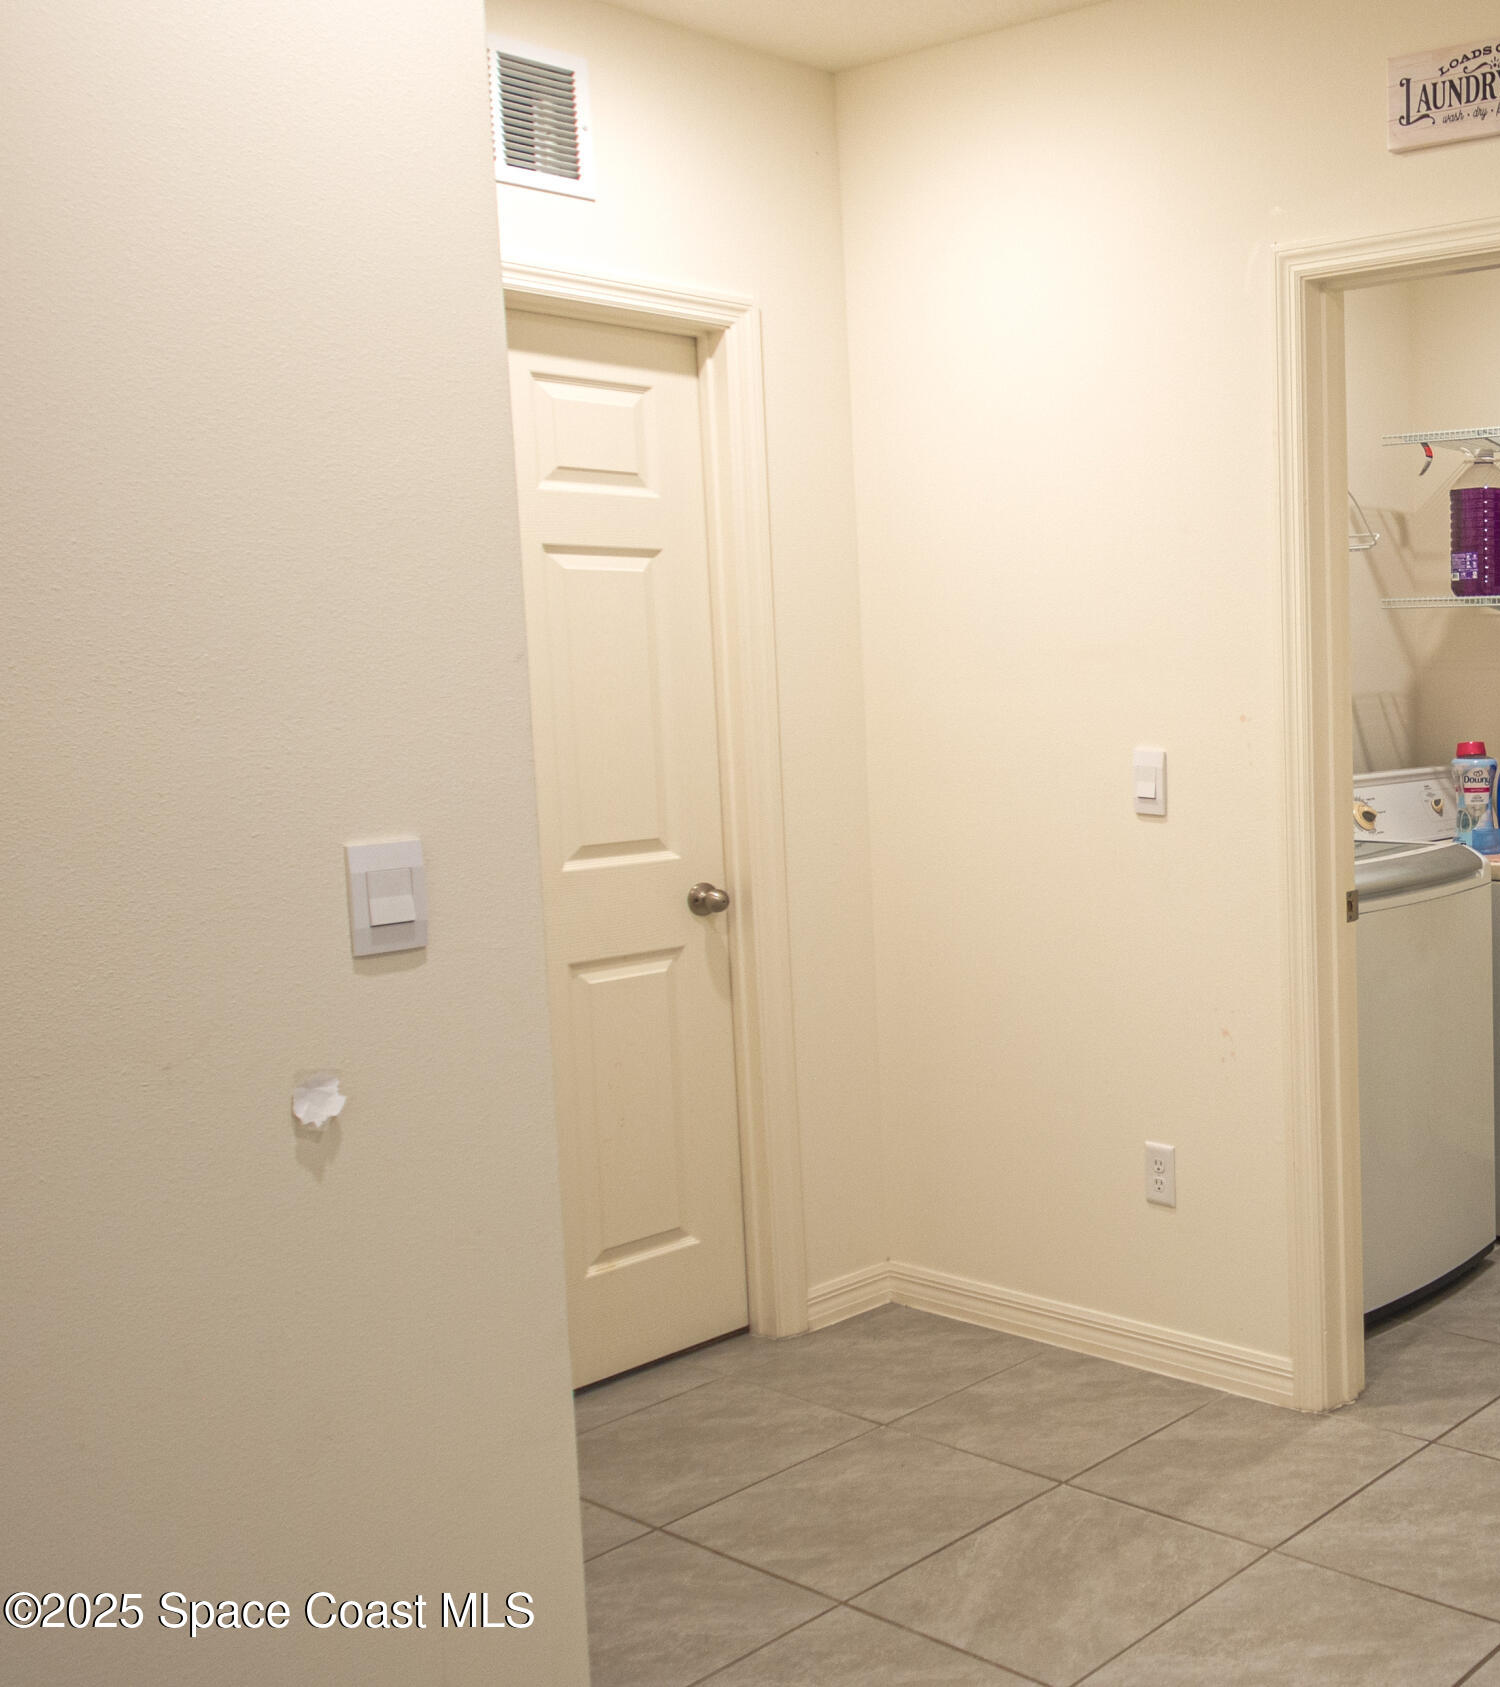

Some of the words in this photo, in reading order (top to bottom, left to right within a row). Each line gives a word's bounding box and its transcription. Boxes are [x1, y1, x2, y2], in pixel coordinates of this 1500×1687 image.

[1439, 46, 1492, 76] LOADS
[1442, 111, 1465, 124] wash
[1472, 105, 1488, 121] dry
[1463, 775, 1491, 786] Downy
